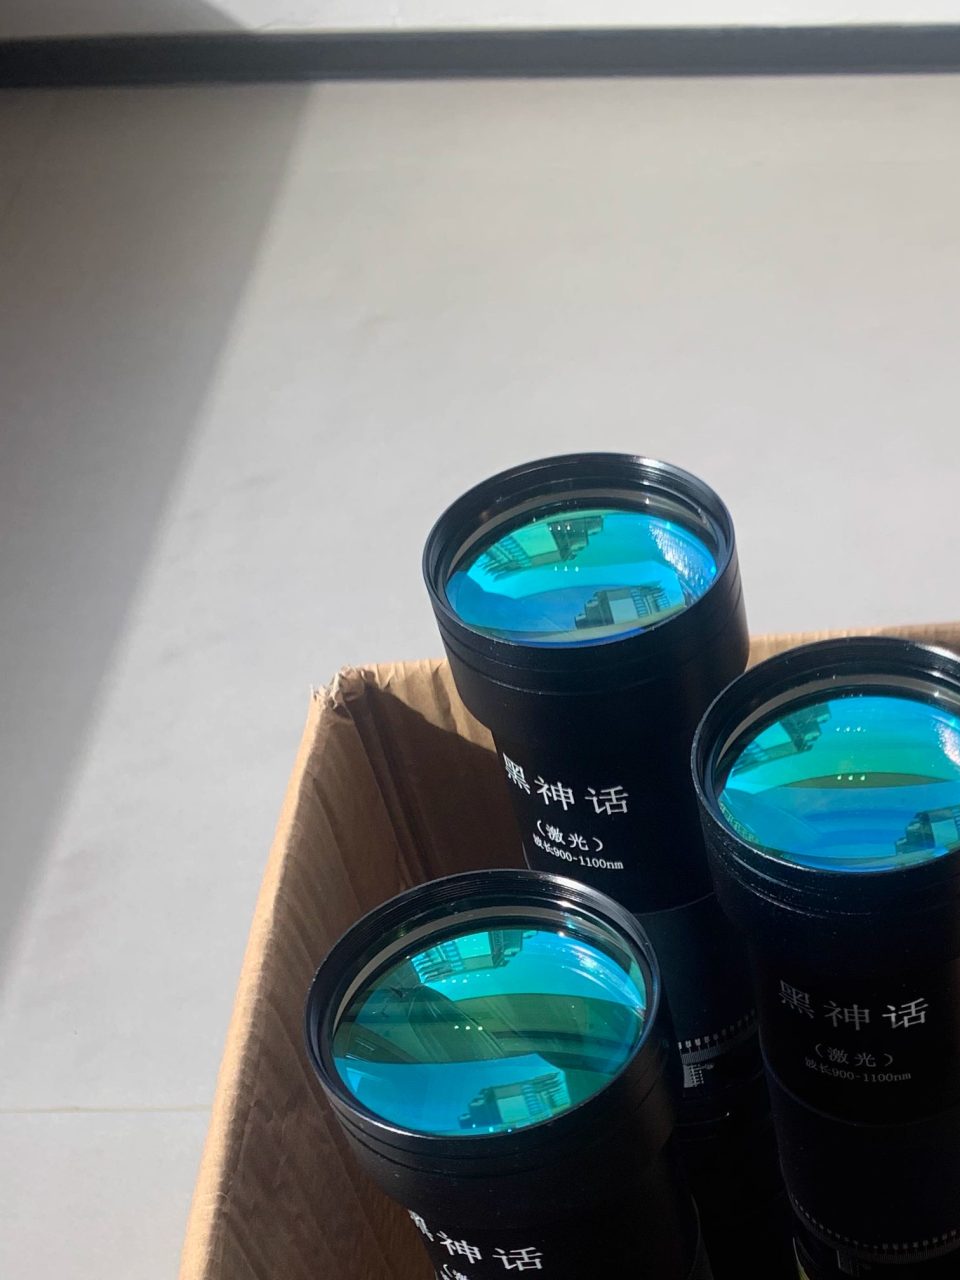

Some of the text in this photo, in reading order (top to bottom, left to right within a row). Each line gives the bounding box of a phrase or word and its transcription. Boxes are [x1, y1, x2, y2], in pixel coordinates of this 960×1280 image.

[503, 752, 629, 815] 黑神话
[779, 979, 929, 1031] 黑神话
